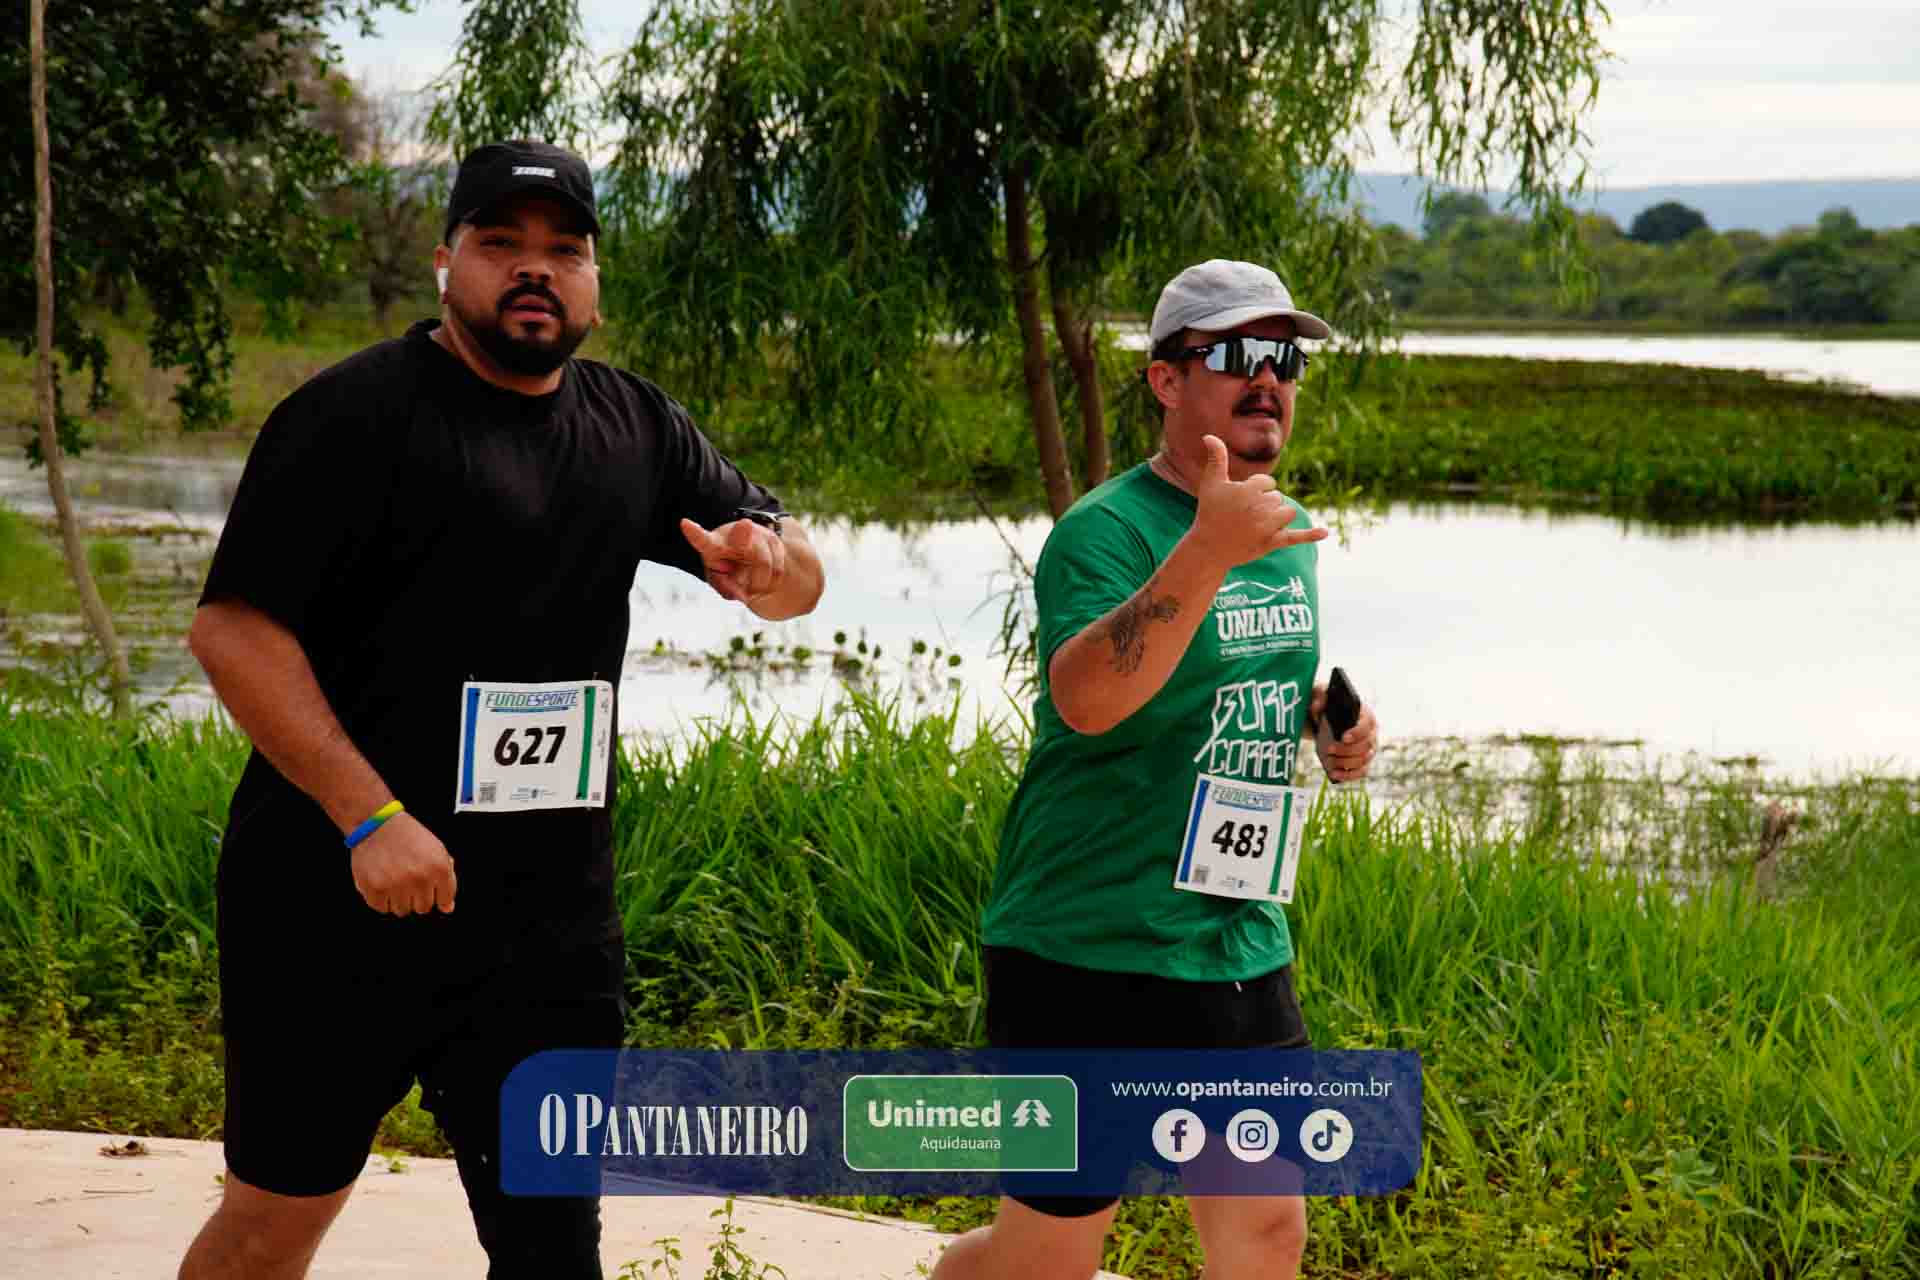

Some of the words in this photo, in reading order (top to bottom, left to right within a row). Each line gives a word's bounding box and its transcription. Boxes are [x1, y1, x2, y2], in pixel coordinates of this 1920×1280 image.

[1216, 604, 1313, 641] UNIMED
[486, 691, 577, 707] FUNDESPORTE
[494, 725, 567, 766] 627
[1211, 820, 1268, 858] 483
